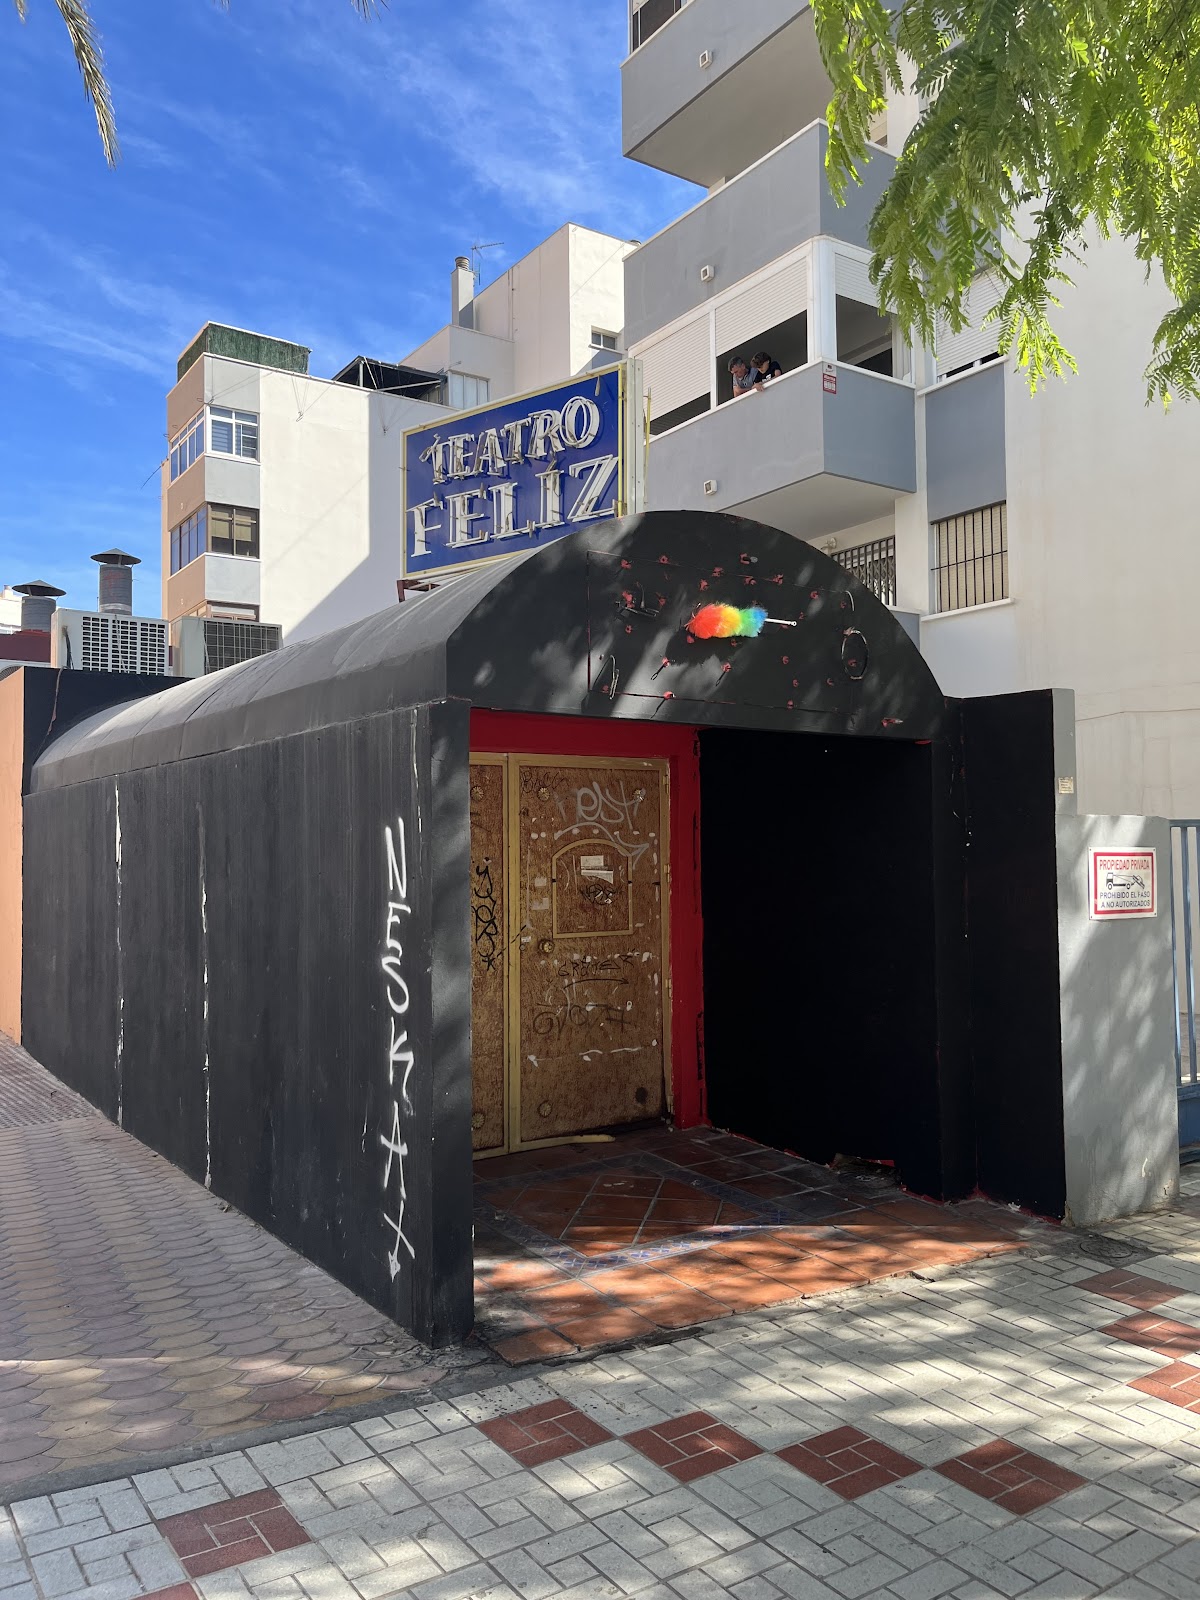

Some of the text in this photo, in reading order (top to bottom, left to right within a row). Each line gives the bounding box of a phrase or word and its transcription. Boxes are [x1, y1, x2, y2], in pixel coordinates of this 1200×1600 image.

[418, 395, 600, 485] TEATRO
[1099, 859, 1150, 870] PROPIEDAD PRIVADA
[1099, 891, 1130, 899] PROHIBIDO
[1115, 899, 1151, 908] AUTORIZADOS
